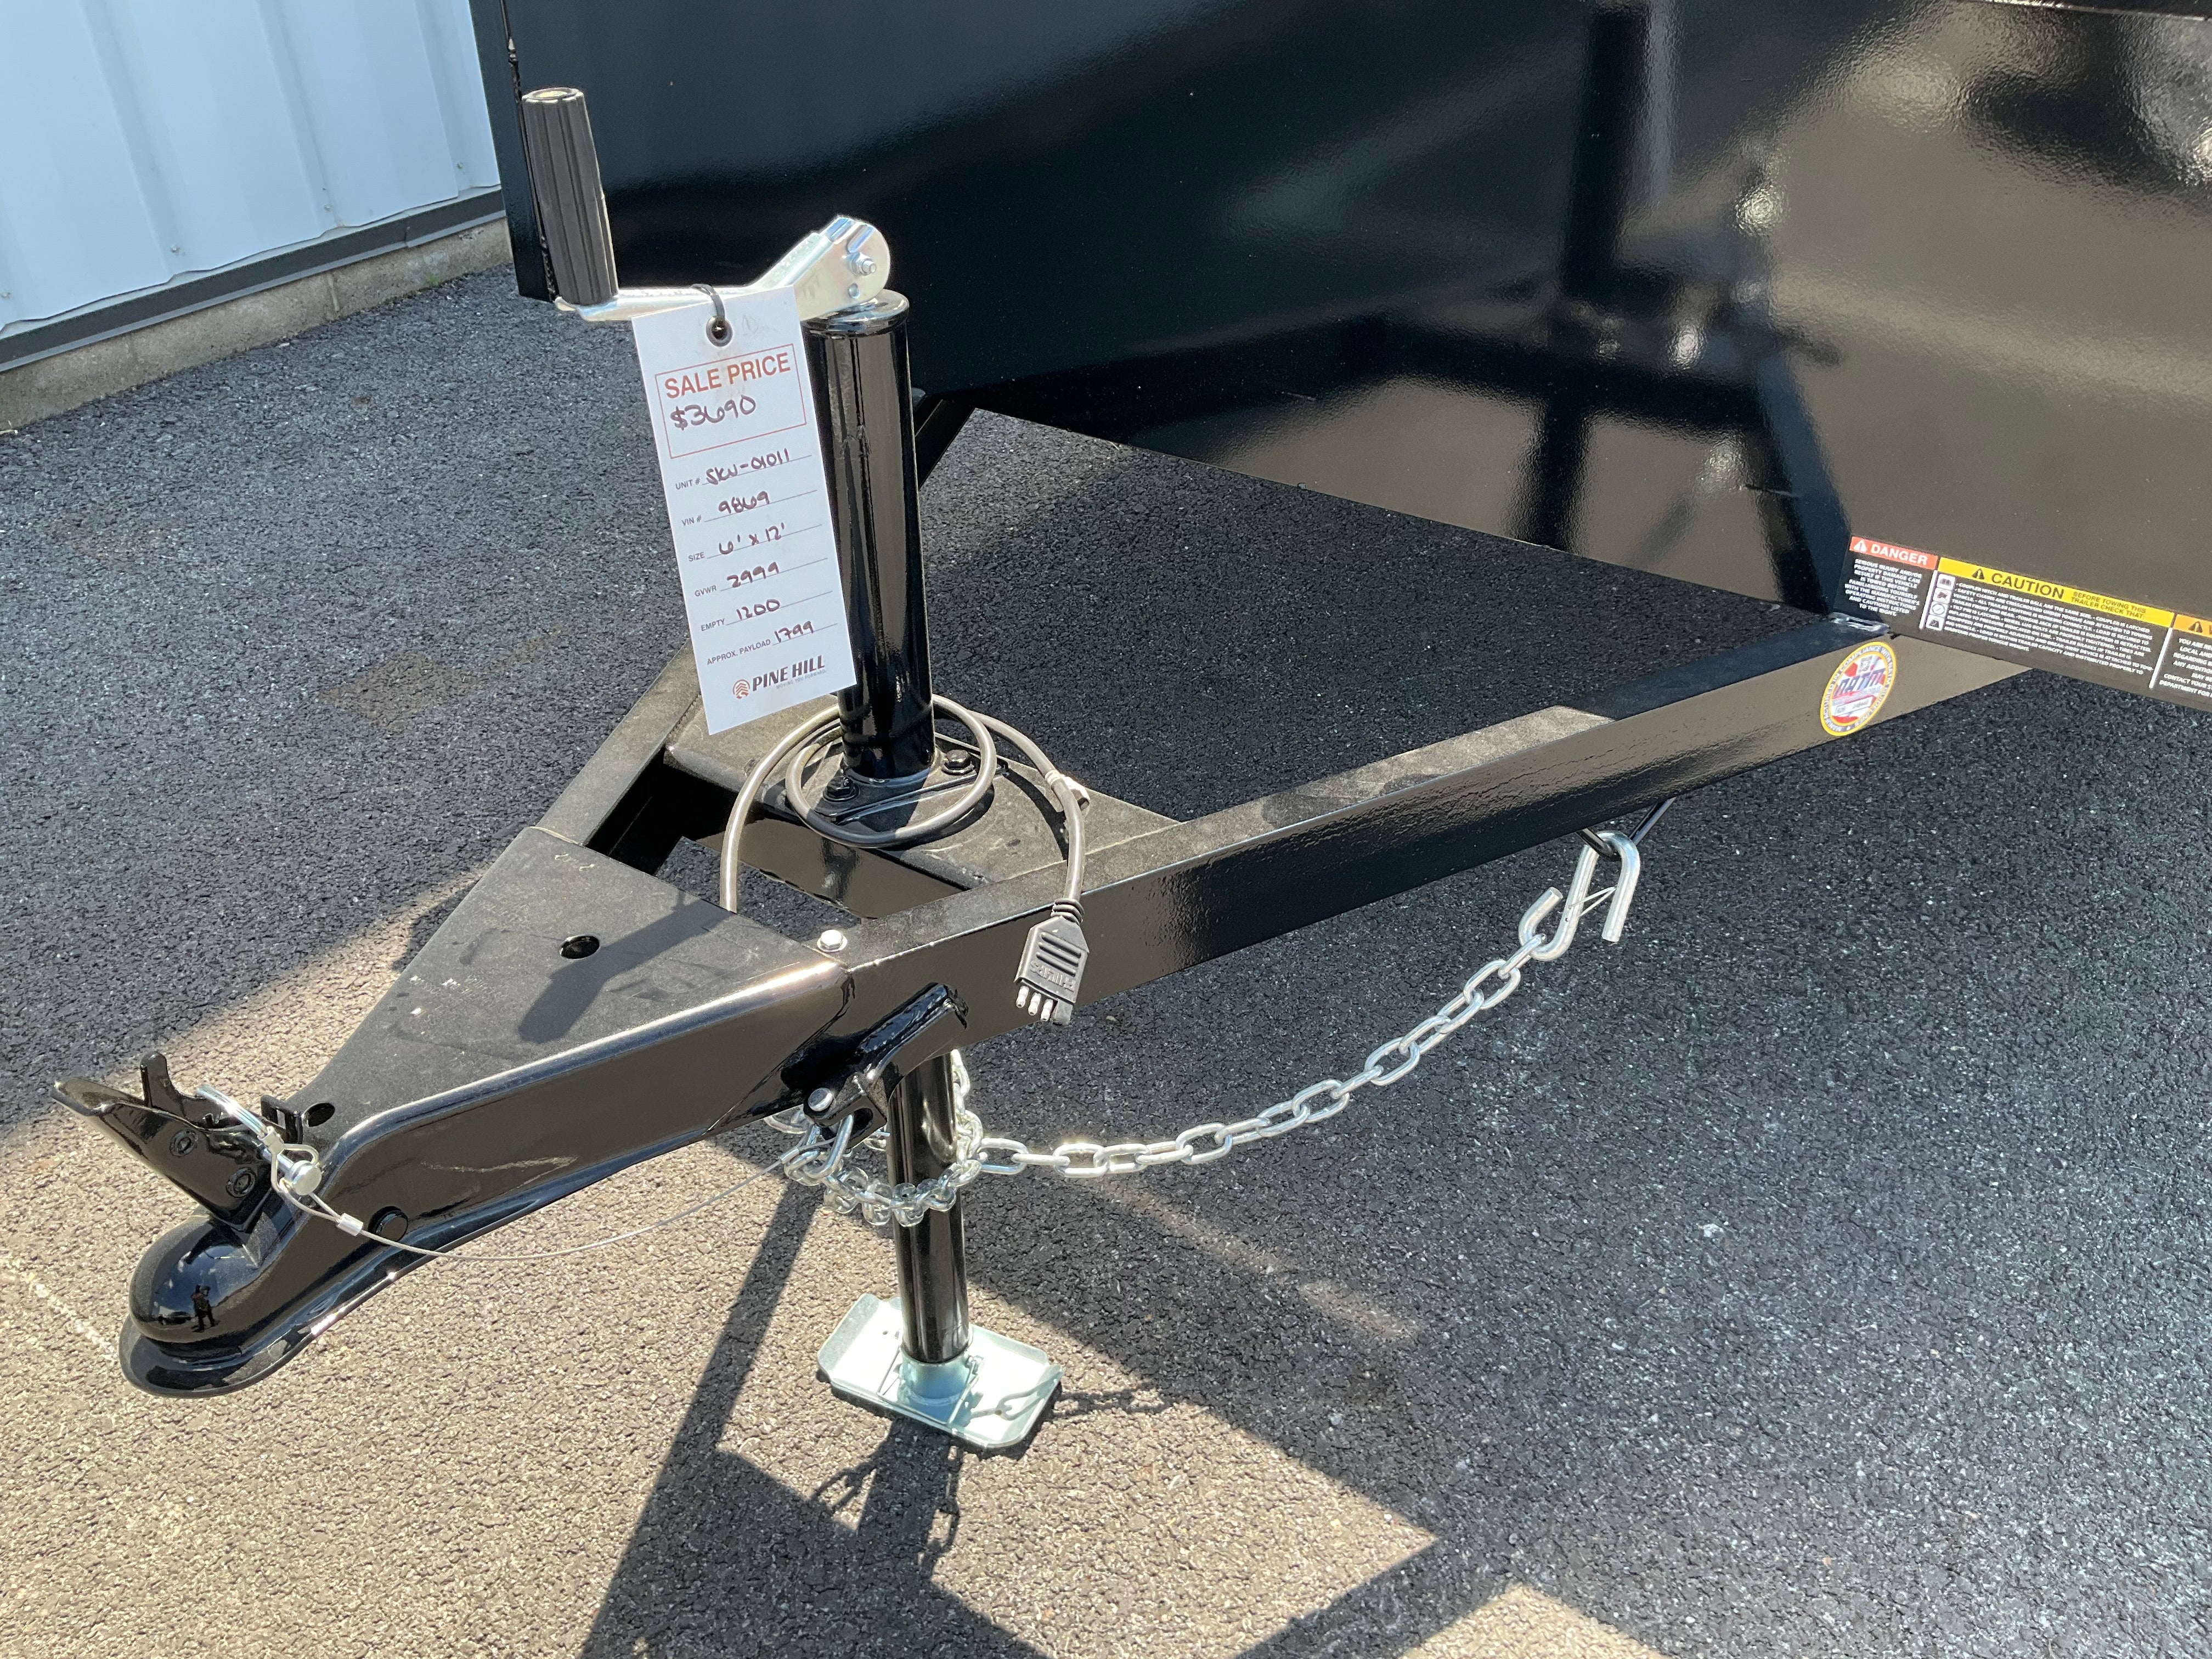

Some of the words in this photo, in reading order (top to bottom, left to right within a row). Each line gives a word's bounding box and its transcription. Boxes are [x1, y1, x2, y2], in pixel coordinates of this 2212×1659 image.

[664, 368, 722, 398] SALE
[726, 352, 791, 385] PRICE
[670, 394, 756, 431] $3690
[675, 479, 692, 490] UNIT
[718, 490, 770, 517] 9869
[681, 517, 695, 526] VIN
[696, 515, 702, 523] #
[688, 551, 705, 562] SIZE
[1870, 543, 1928, 566] DANGER
[726, 561, 779, 588] 2999
[1853, 563, 1882, 574] PROPERTY
[1882, 570, 1907, 580] DAMAGE
[1854, 558, 1878, 568] SERIOUS
[1878, 563, 1899, 573] INJURY
[1899, 568, 1922, 578] AND/OR
[1854, 569, 1874, 578] RESULT
[1894, 578, 1917, 588] VEHICLE
[1866, 577, 1887, 586] TOWED
[1887, 582, 1909, 591] BEFORE
[1990, 571, 2065, 600] CAUTION
[694, 584, 716, 596] GVWR
[1848, 578, 1889, 592] FAMILIARIZING
[1889, 588, 1917, 600] YOURSELF
[1870, 589, 1920, 606] MANUFACTURER'S
[1845, 589, 1876, 600] OPERATING
[1876, 596, 1916, 610] INSTRUCTIONS
[1861, 598, 1890, 609] CAUTIONS
[1890, 605, 1910, 614] LISTED
[2069, 596, 2100, 608] TRAILER
[2100, 603, 2124, 614] CHECK
[2072, 591, 2101, 602] BEFORE
[2101, 598, 2129, 610] TOWING
[2130, 605, 2147, 614] THIS
[736, 599, 780, 620] 1200
[701, 618, 724, 631] EMPTY
[774, 620, 814, 643] 1799
[707, 650, 737, 665] APPROX.
[739, 639, 771, 654] PAYLOAD
[2172, 652, 2208, 665] REGARDING
[2179, 646, 2199, 655] LOCAL
[752, 666, 788, 691] PINE
[792, 654, 825, 678] HILL
[2163, 673, 2191, 684] CONTACT
[2158, 679, 2198, 694] DEPARTMENT
